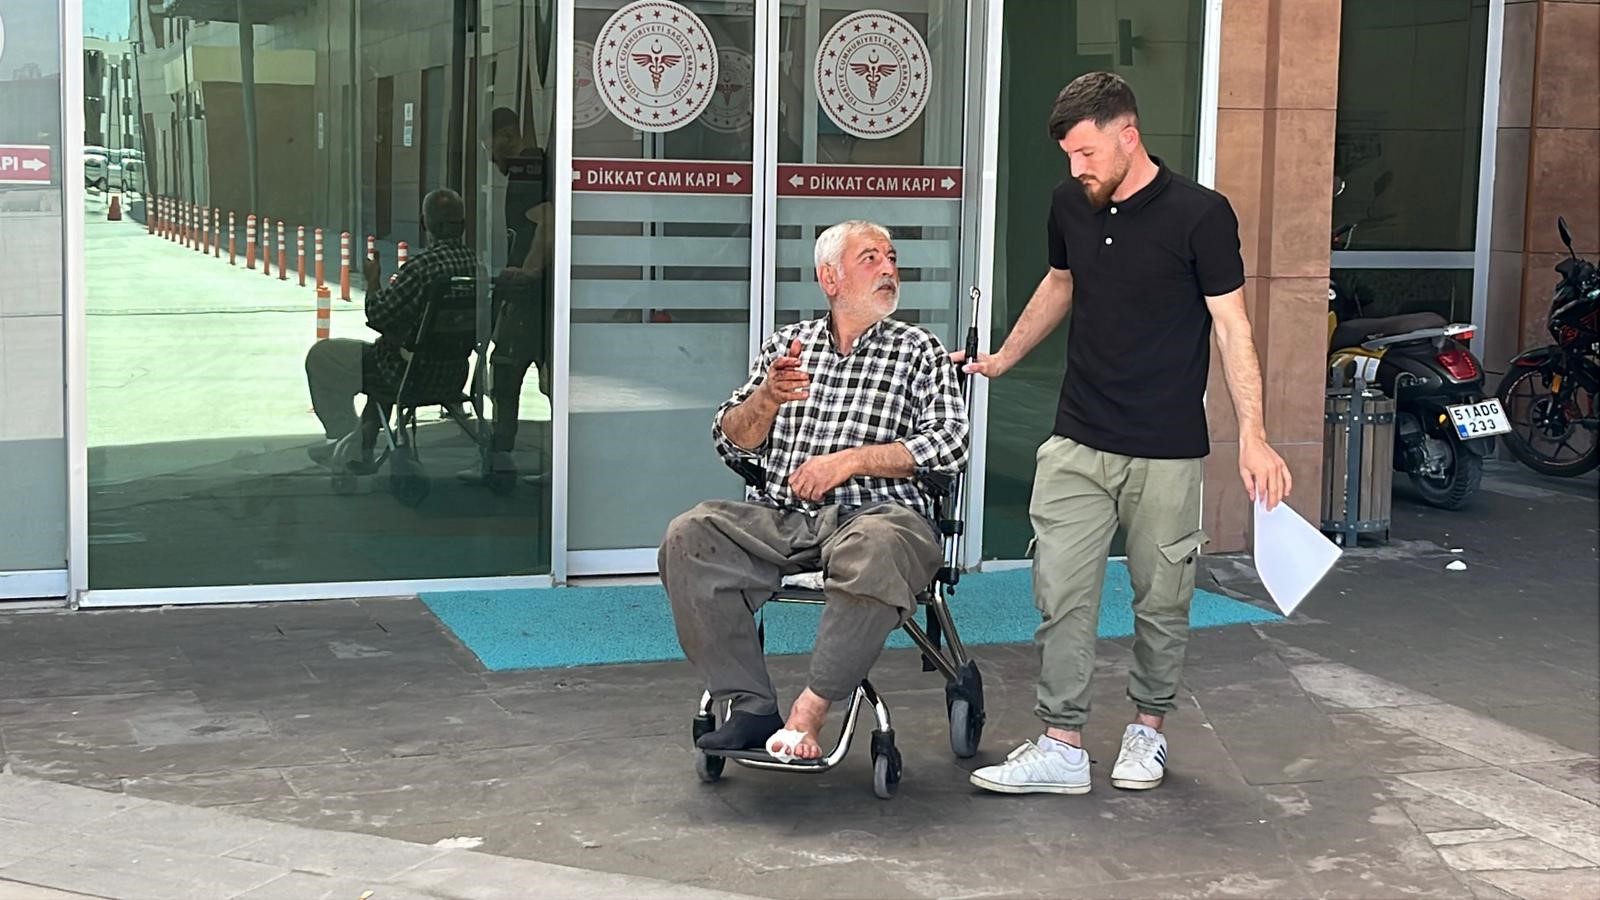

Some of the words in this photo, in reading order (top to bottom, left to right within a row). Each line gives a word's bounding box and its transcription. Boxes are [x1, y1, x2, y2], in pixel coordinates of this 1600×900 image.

[0, 156, 18, 171] PI
[587, 167, 644, 185] DİKKAT
[647, 171, 681, 186] CAM
[685, 172, 720, 187] KAPI
[810, 172, 863, 190] DİKKAT
[866, 177, 898, 191] CAM
[902, 177, 935, 191] KAPI
[1469, 419, 1496, 433] 233
